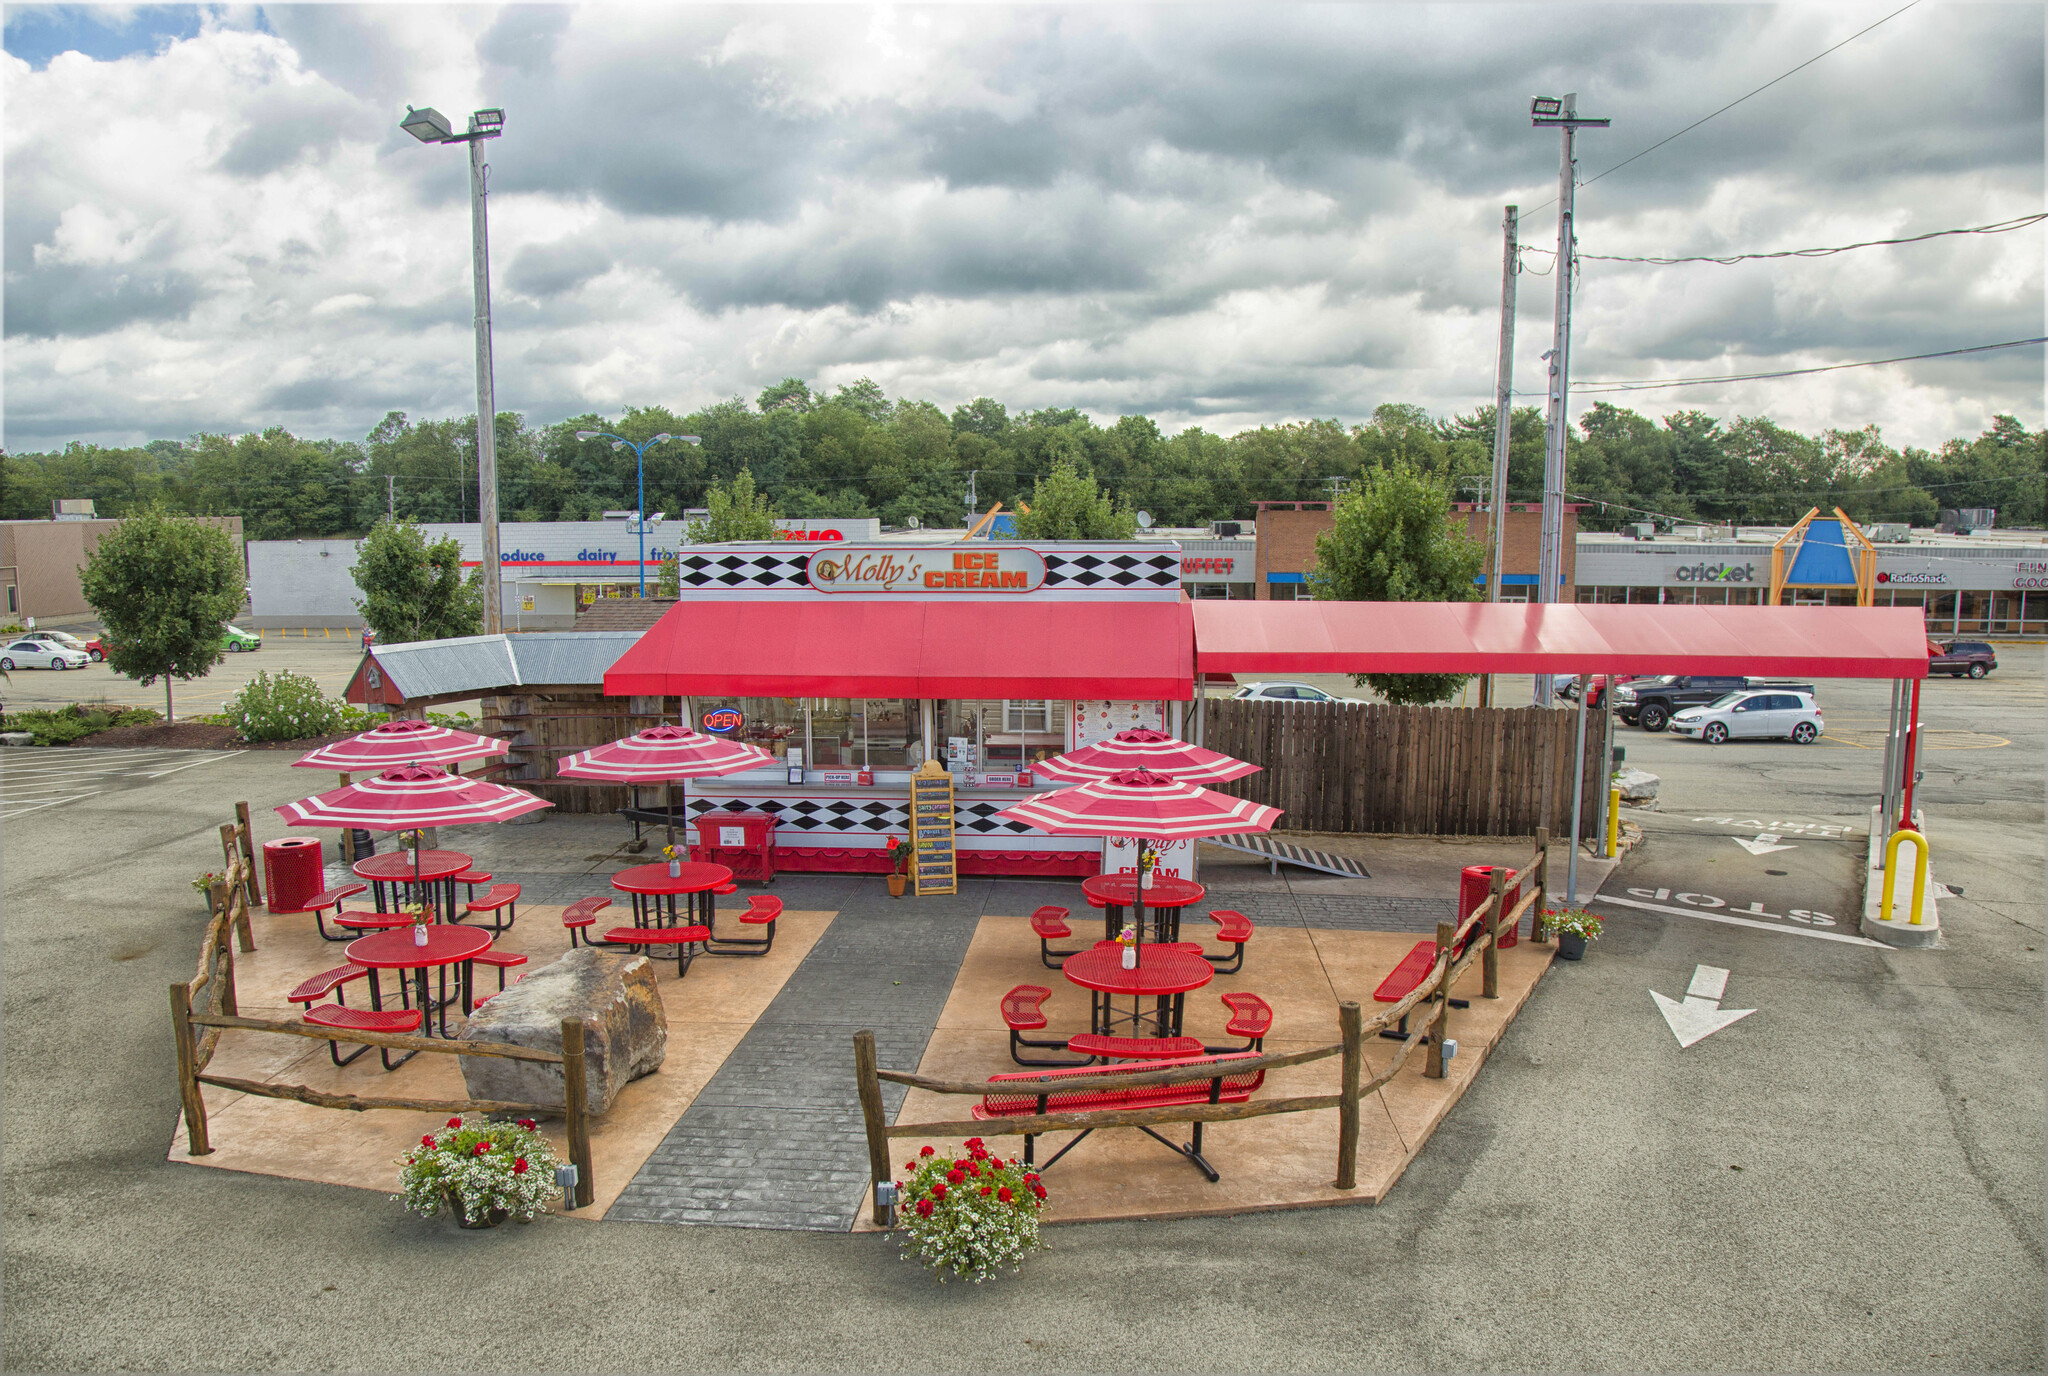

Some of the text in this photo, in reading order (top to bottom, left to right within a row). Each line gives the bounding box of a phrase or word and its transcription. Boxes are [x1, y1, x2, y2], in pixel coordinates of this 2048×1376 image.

[577, 548, 617, 564] dairy
[953, 552, 999, 570] ICE
[817, 553, 922, 590] Molly's
[1676, 562, 1754, 581] cricket
[2016, 562, 2047, 573] FIN
[924, 571, 1028, 588] CREAM
[1889, 573, 1947, 584] RadioShack
[703, 713, 743, 728] OPEN
[1119, 866, 1179, 878] CRAM
[1627, 888, 1838, 926] STOP
